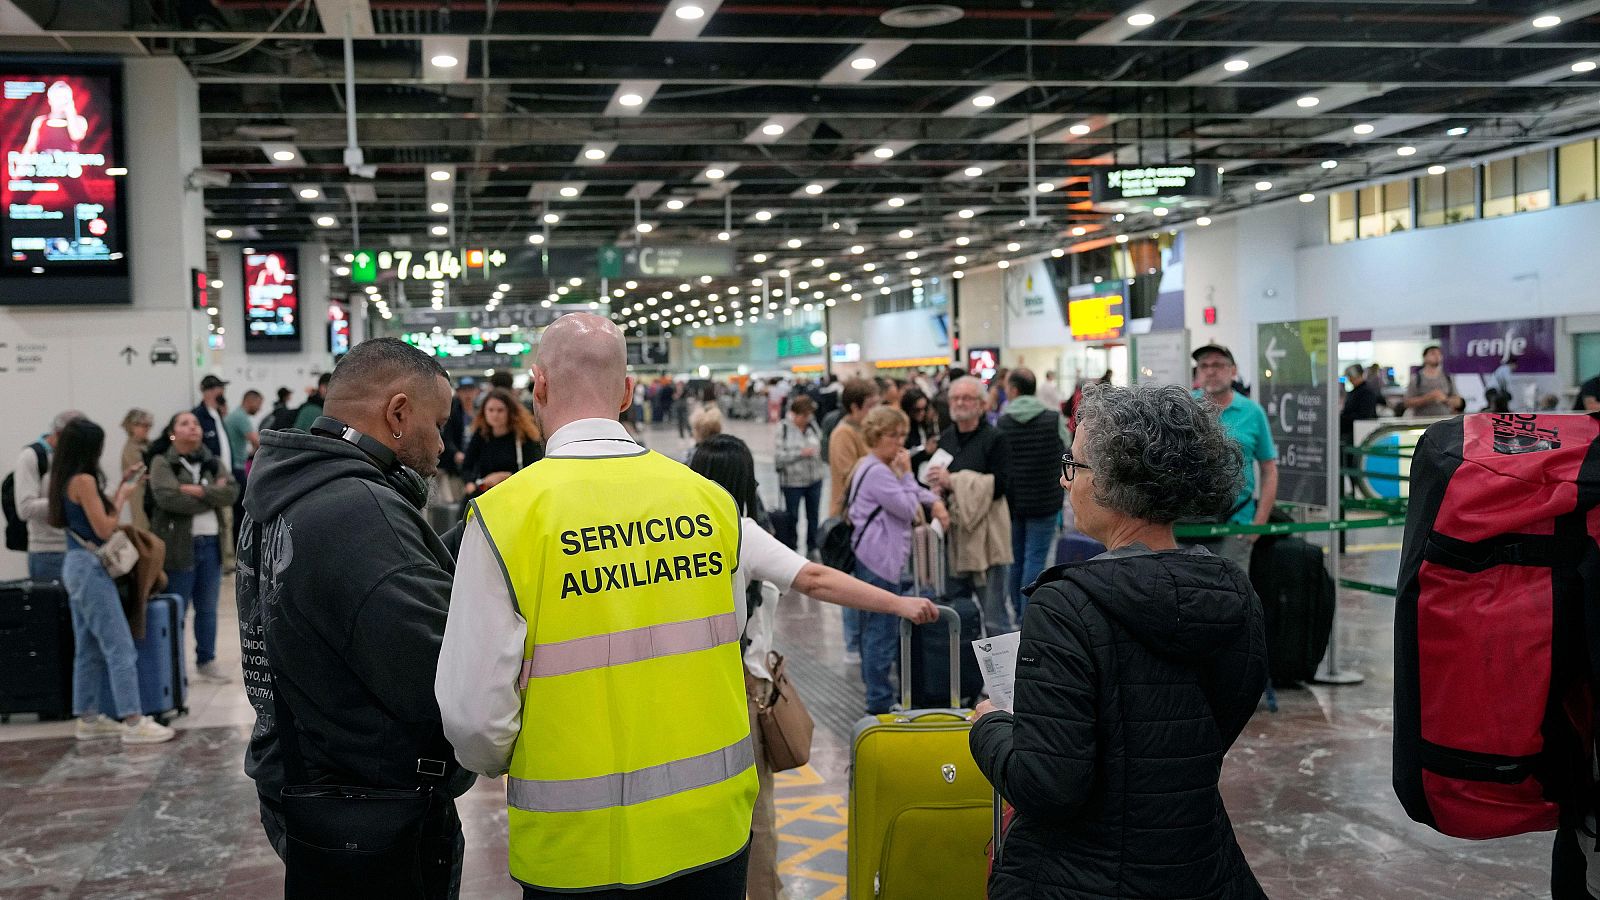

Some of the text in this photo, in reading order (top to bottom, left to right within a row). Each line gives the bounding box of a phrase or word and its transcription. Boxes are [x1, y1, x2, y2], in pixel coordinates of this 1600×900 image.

[639, 247, 655, 274] C
[1467, 328, 1527, 364] renfe
[1280, 392, 1293, 432] C
[560, 513, 714, 556] SERVICIOS
[560, 551, 723, 600] AUXILIARES
